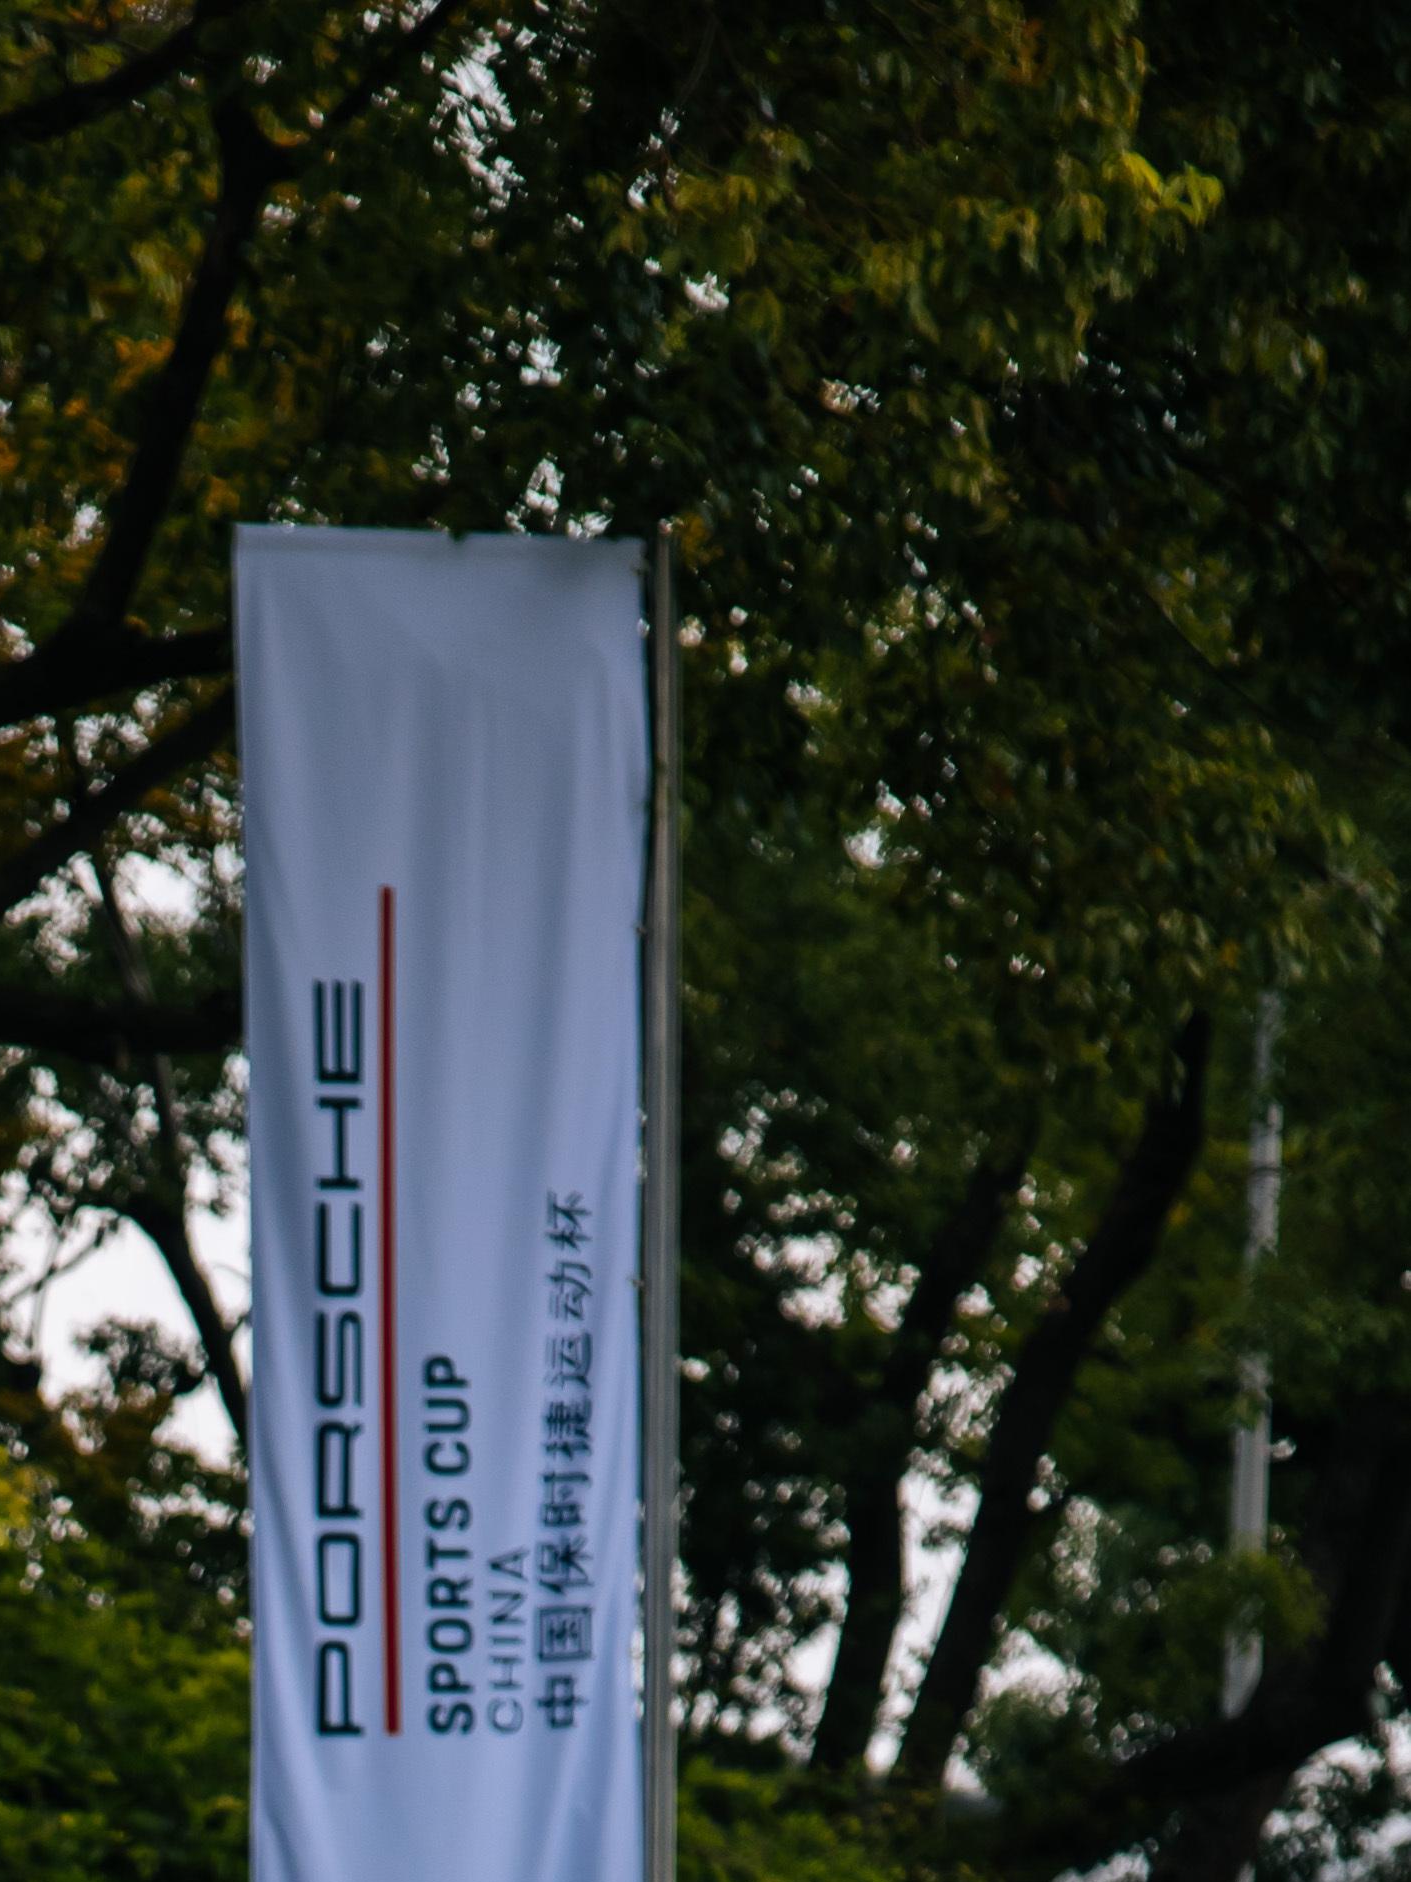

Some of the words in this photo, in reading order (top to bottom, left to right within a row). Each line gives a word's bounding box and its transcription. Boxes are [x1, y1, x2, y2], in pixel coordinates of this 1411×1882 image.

[313, 978, 365, 1737] PORSCHE
[422, 1354, 472, 1478] CUP
[536, 1189, 594, 1731] 中国保时捷运动杯
[424, 1497, 475, 1736] SPORTS
[486, 1545, 530, 1736] CHINA
